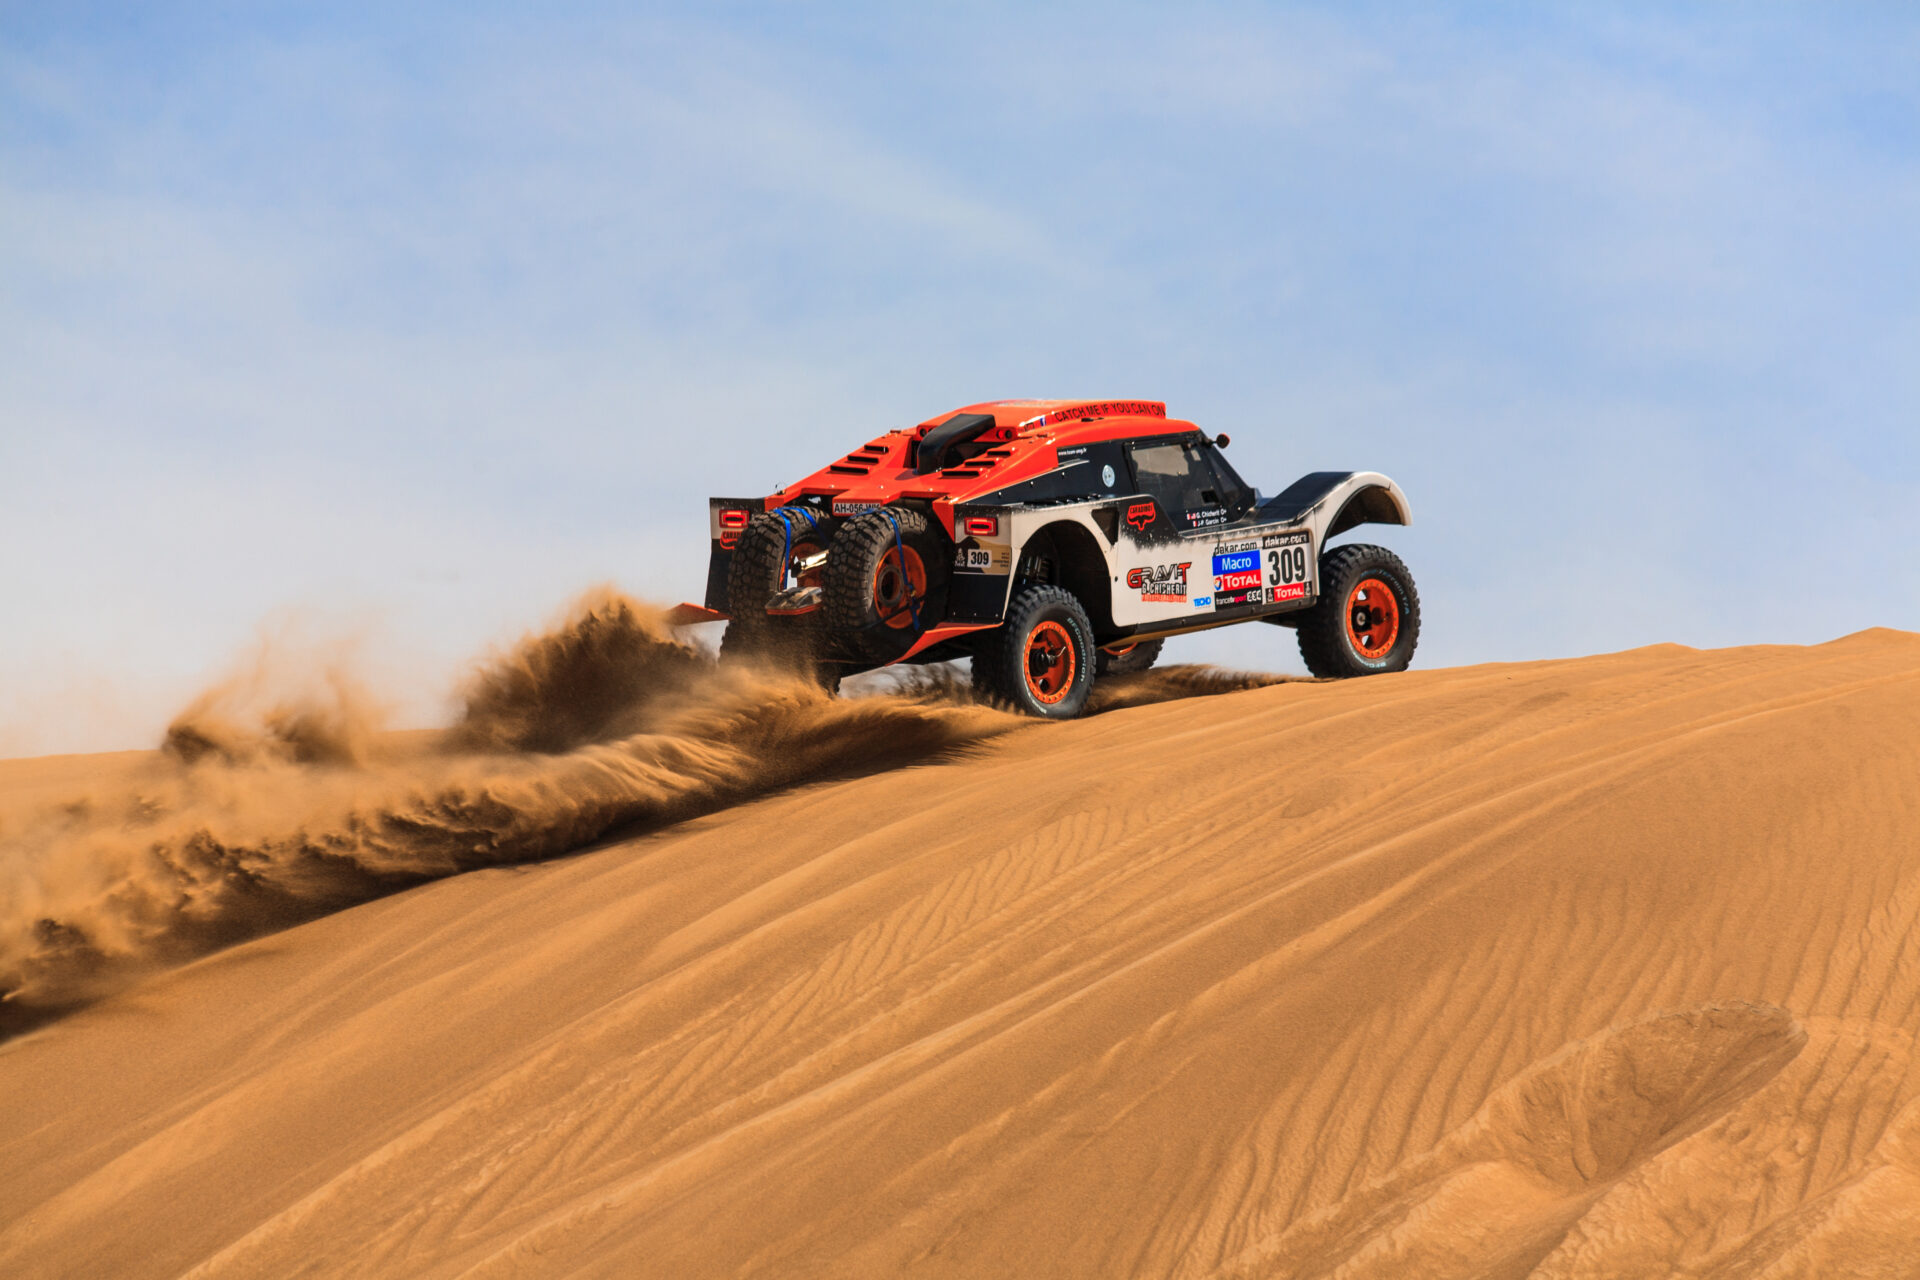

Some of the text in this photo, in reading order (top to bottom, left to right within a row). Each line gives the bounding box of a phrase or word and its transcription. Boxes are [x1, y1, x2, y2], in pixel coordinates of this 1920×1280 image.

[1054, 407, 1086, 422] CATCH
[1086, 404, 1101, 415] ME
[1101, 404, 1109, 414] IF
[1110, 403, 1131, 414] YOU
[1131, 403, 1151, 415] CAN
[1214, 541, 1258, 555] dakar.com
[970, 551, 990, 565] 309
[1221, 557, 1252, 571] Macro
[1268, 546, 1306, 586] 309
[1224, 574, 1260, 588] TOTAL
[1150, 582, 1187, 595] CHICHERIT
[1275, 587, 1304, 599] TOTAL
